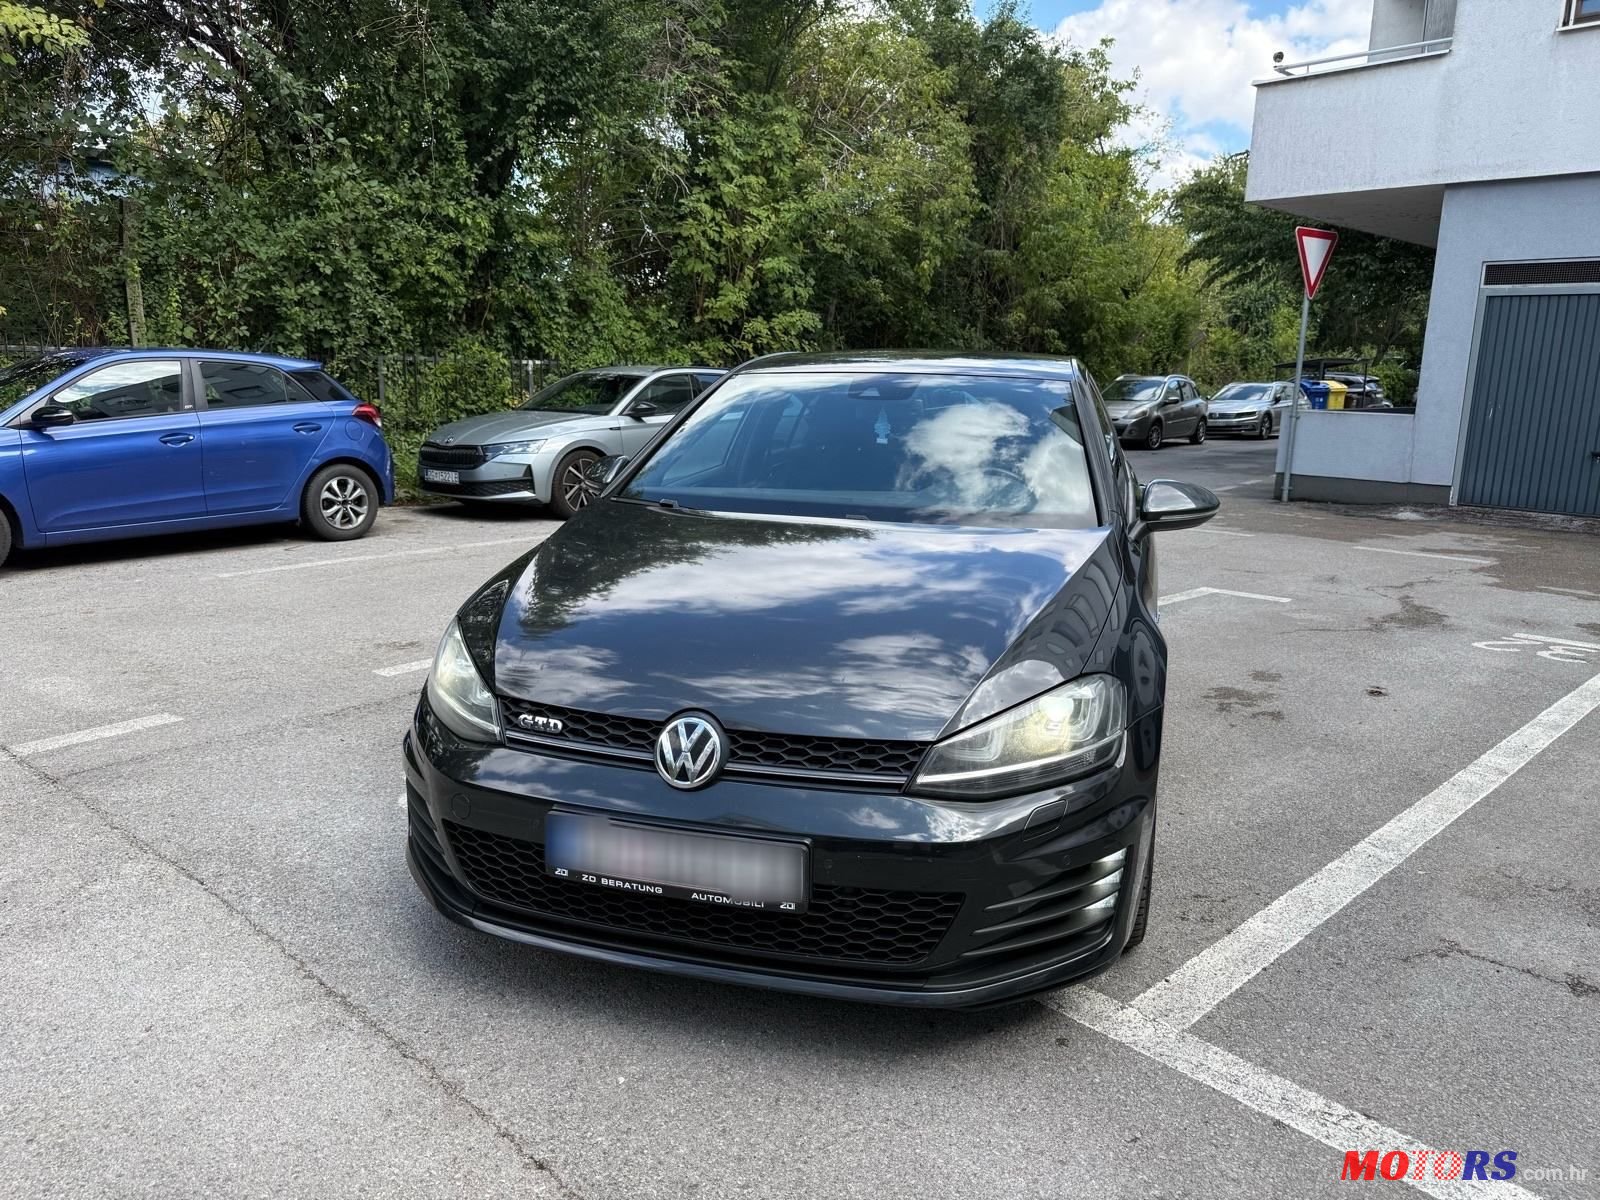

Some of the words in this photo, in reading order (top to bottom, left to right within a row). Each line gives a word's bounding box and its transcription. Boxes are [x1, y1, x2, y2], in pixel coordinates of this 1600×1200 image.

[517, 714, 563, 734] GTD
[656, 716, 721, 784] VW
[601, 878, 663, 894] BERATUNG
